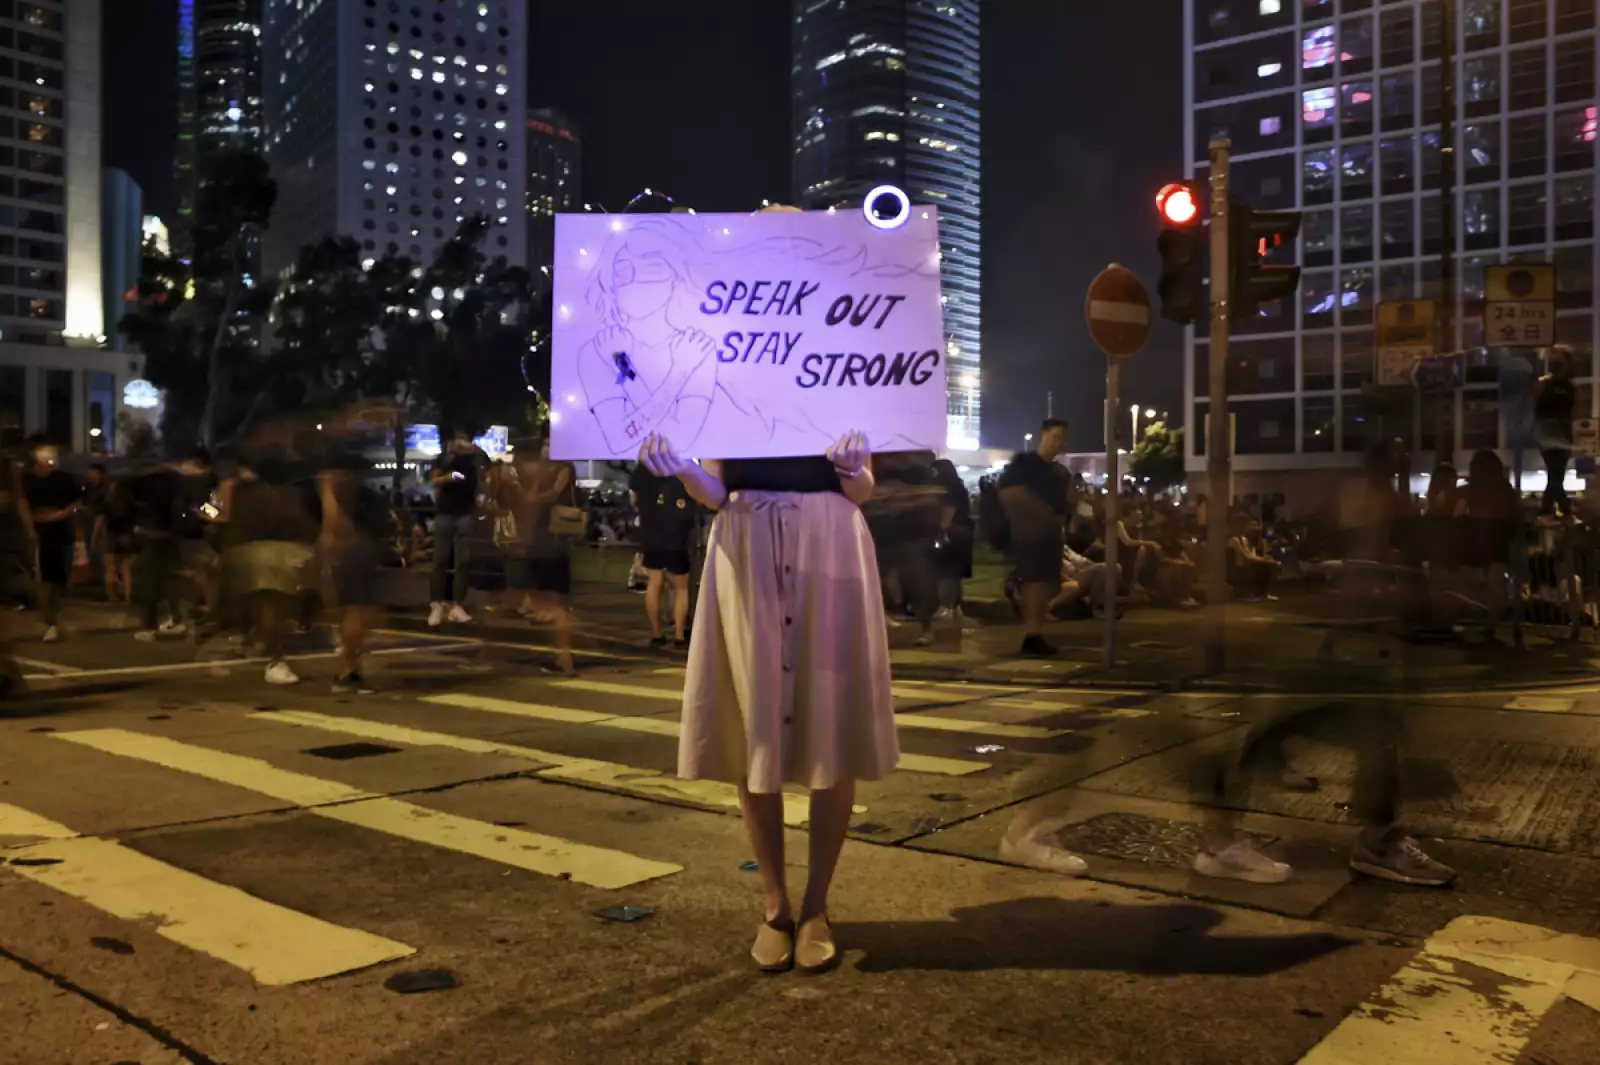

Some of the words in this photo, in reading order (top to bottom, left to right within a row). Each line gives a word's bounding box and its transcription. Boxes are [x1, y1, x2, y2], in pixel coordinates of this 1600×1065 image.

[700, 280, 821, 316] SPEAK
[825, 294, 905, 330] OUT
[1495, 307, 1515, 320] 24
[1520, 305, 1545, 320] hrs
[1500, 324, 1541, 341] 全日
[716, 331, 803, 365] STAY
[796, 349, 940, 389] STRONG
